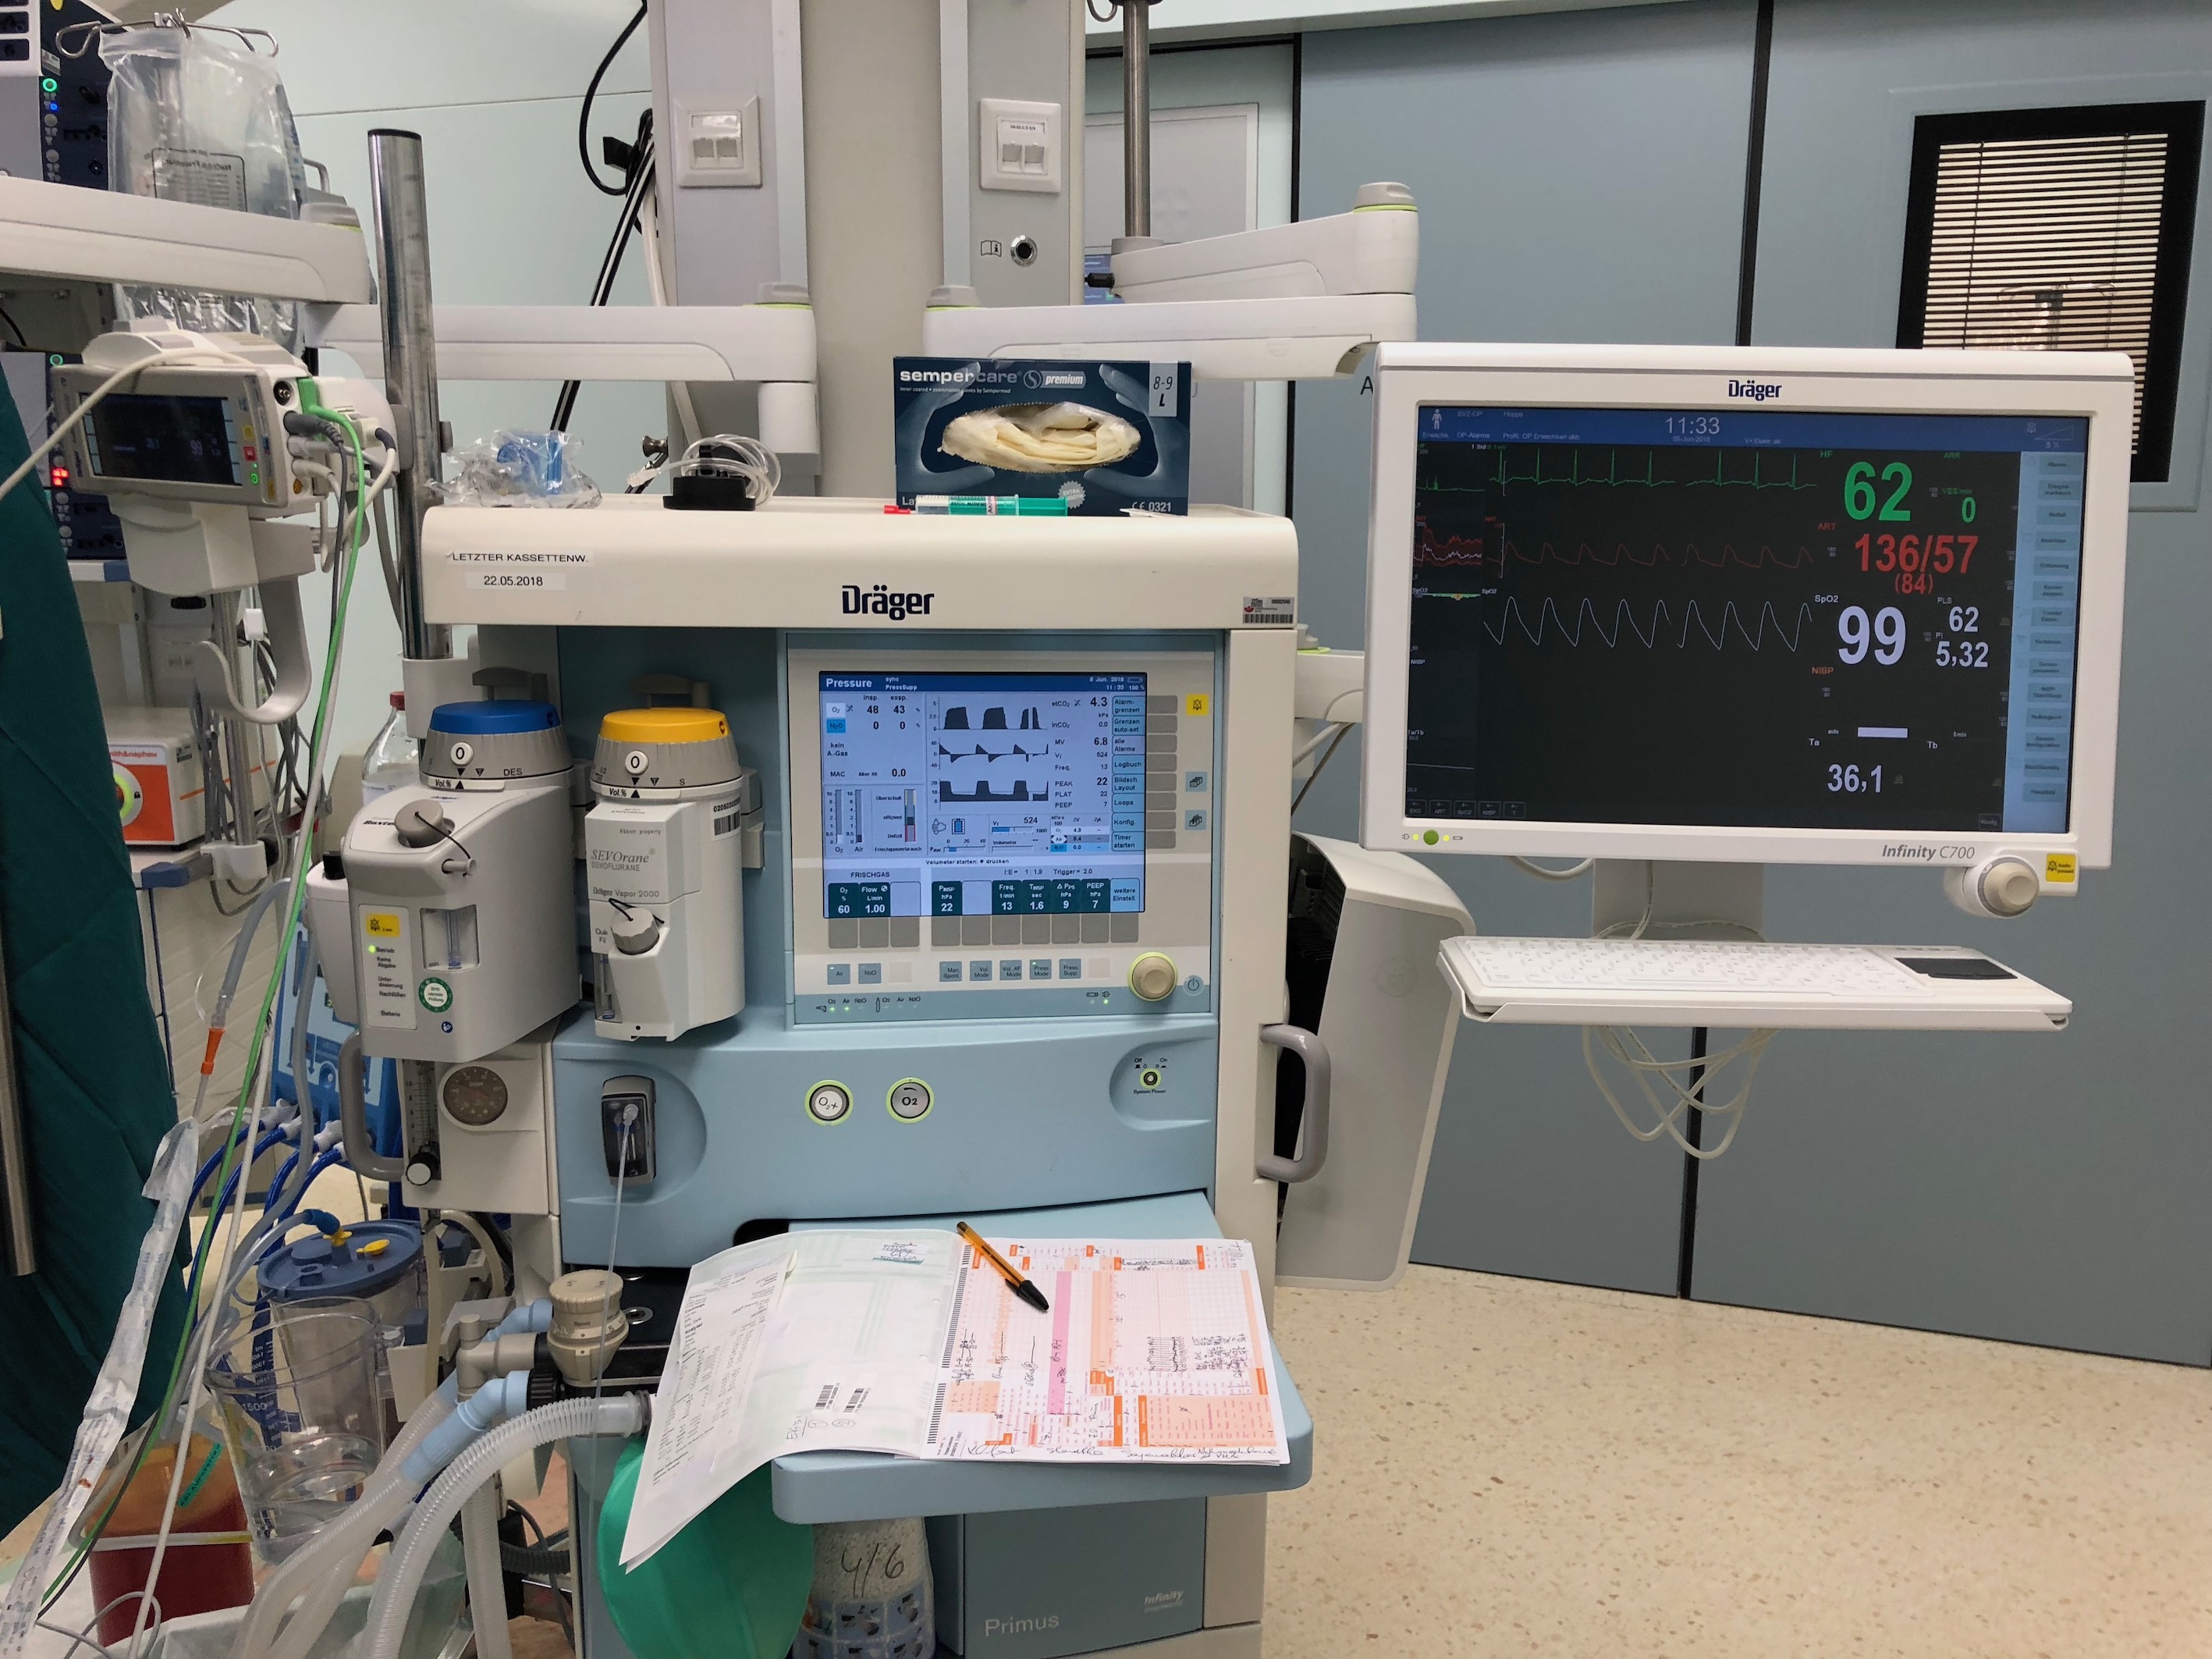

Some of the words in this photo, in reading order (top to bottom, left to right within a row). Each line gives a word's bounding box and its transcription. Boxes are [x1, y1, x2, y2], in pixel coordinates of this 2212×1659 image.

[1046, 373, 1084, 385] premium
[1153, 376, 1173, 390] 8-9
[1728, 379, 1782, 401] Dräger
[1159, 393, 1166, 407] L
[1665, 417, 1720, 435] 11:33
[1844, 461, 1913, 521] 62
[1149, 501, 1171, 512] 0321
[1962, 497, 1976, 523] 0
[507, 554, 588, 563] KASSETTENW.
[1855, 533, 1979, 574] 136/57
[484, 575, 543, 586] 22.05.2018
[1894, 574, 1933, 594] (84)
[841, 584, 935, 621] Dräger
[1815, 595, 1838, 603] SpO2
[1949, 606, 1979, 632] 62
[1837, 606, 1906, 665] 99
[1936, 641, 1990, 667] 5,32
[826, 678, 872, 687] Pressure
[1090, 697, 1108, 706] 4.3
[867, 705, 879, 714] 48
[893, 705, 905, 714] 43
[873, 721, 879, 730] 0
[900, 721, 905, 730] 0
[1094, 737, 1108, 746] 6.8
[456, 747, 465, 759] 0
[630, 756, 640, 769] 0
[892, 769, 906, 777] 0.0
[1827, 763, 1883, 793] 36,1
[435, 780, 451, 788] Vol.%
[1097, 777, 1108, 786] 22
[609, 788, 627, 797] Vol.%
[1882, 844, 1937, 861] Infinity
[1940, 846, 1976, 858] C700
[591, 861, 641, 872] SEVOFLURANE
[838, 904, 850, 914] 60
[865, 904, 886, 913] 1.00
[941, 903, 953, 911] 22
[1002, 901, 1013, 910] 13
[1030, 901, 1044, 910] 1.6
[1063, 900, 1069, 909] 9
[1093, 900, 1099, 909] 7
[902, 1096, 918, 1107] O2
[985, 1614, 1060, 1637] Primus
